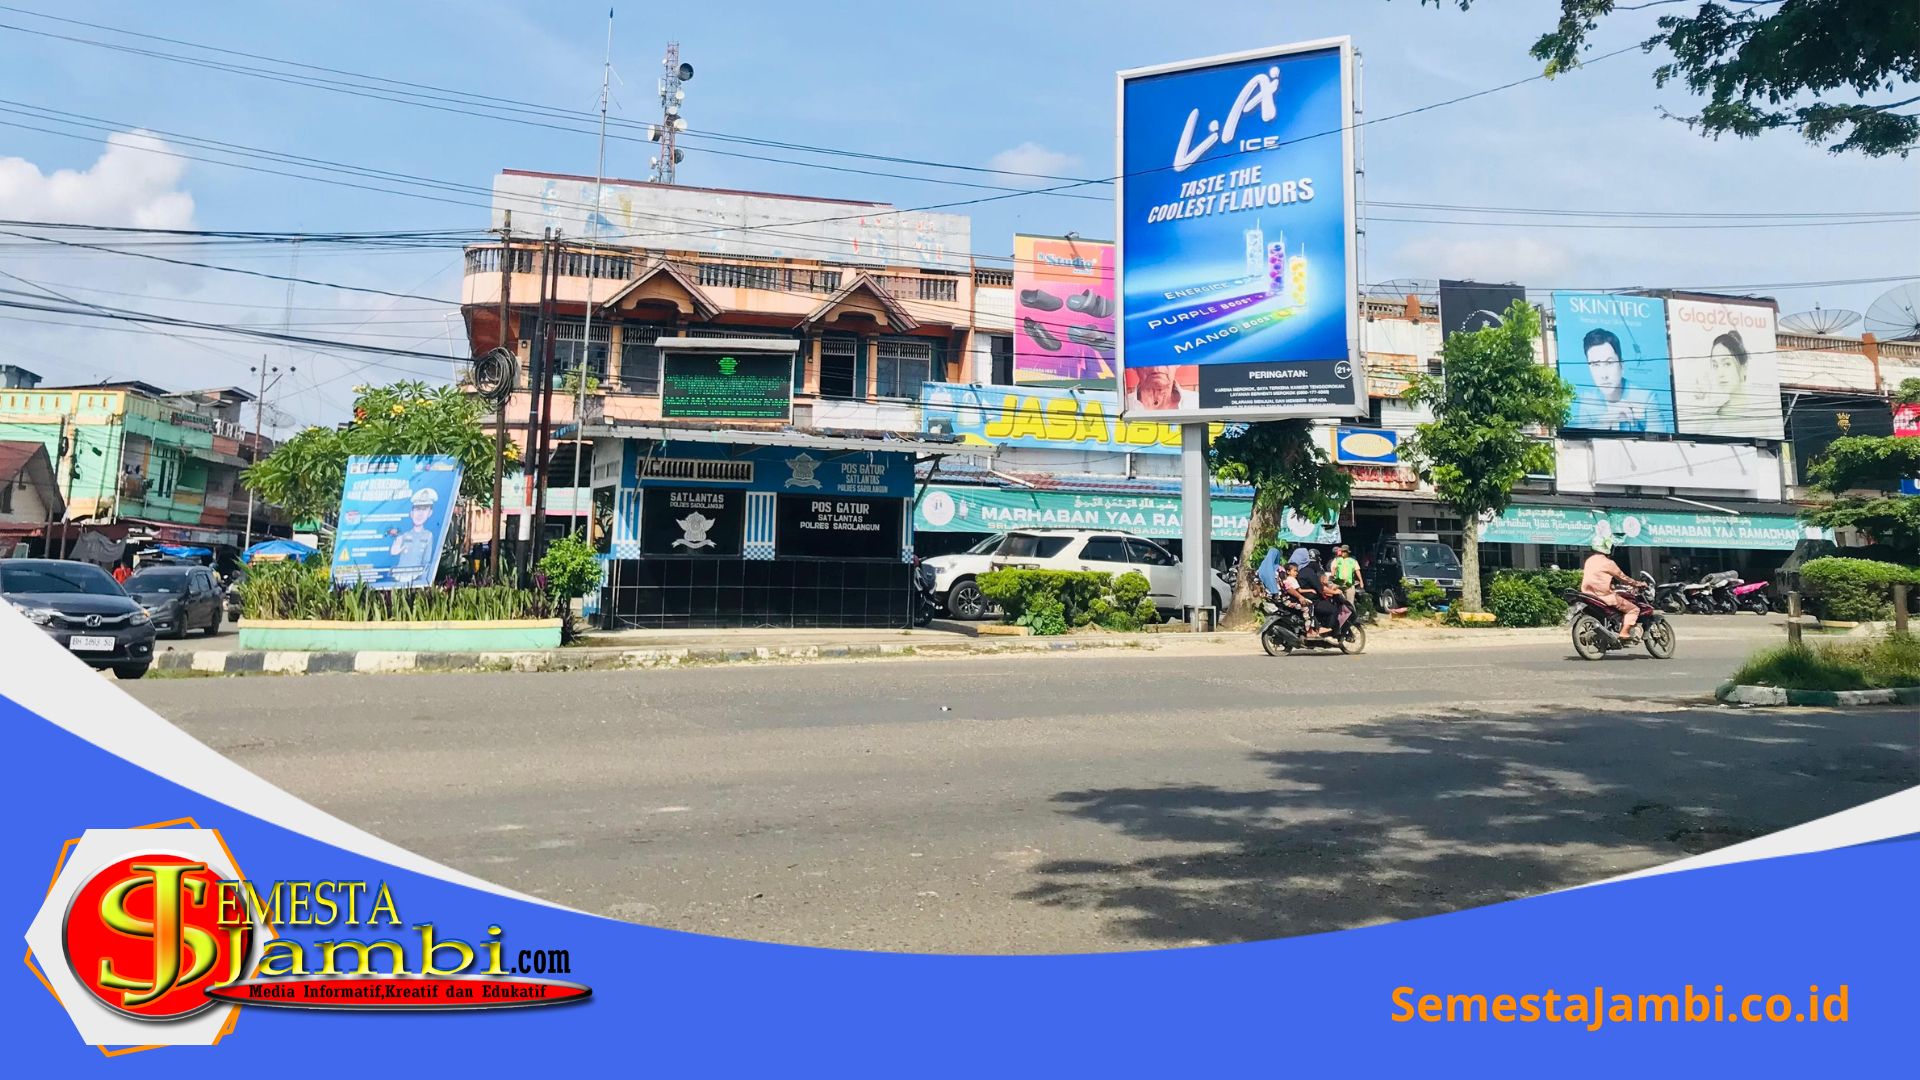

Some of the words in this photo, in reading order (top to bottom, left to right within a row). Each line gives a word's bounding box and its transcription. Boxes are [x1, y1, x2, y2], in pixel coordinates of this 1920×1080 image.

[1240, 136, 1280, 152] ICE
[1180, 173, 1225, 198] TASTE
[1230, 166, 1262, 188] THE
[1148, 194, 1216, 223] COOLEST
[1218, 178, 1315, 213] FLAVORS
[1570, 298, 1650, 318] SKINTIFIC
[1148, 307, 1217, 330] PURPLE
[1678, 306, 1767, 330] Glad2Glow
[1174, 326, 1239, 354] MANGO
[1249, 370, 1308, 379] PERINGATAN:
[1337, 366, 1352, 374] 21+
[985, 394, 1108, 445] JASA
[841, 463, 857, 474] POS
[859, 464, 885, 475] GATUR
[846, 474, 880, 485] SATLANTAS
[670, 492, 724, 503] SATLANTAS
[811, 501, 832, 513] POS
[836, 502, 870, 514] GATUR
[818, 514, 863, 523] SATLANTAS
[981, 506, 1099, 524] MARHABAN
[1106, 511, 1147, 525] YAA
[800, 521, 829, 530] POLRES
[833, 523, 880, 531] SAROLANGUN
[1649, 525, 1711, 537] MARHABAN
[1713, 527, 1737, 538] YAA
[1739, 527, 1800, 540] RAMADHAN
